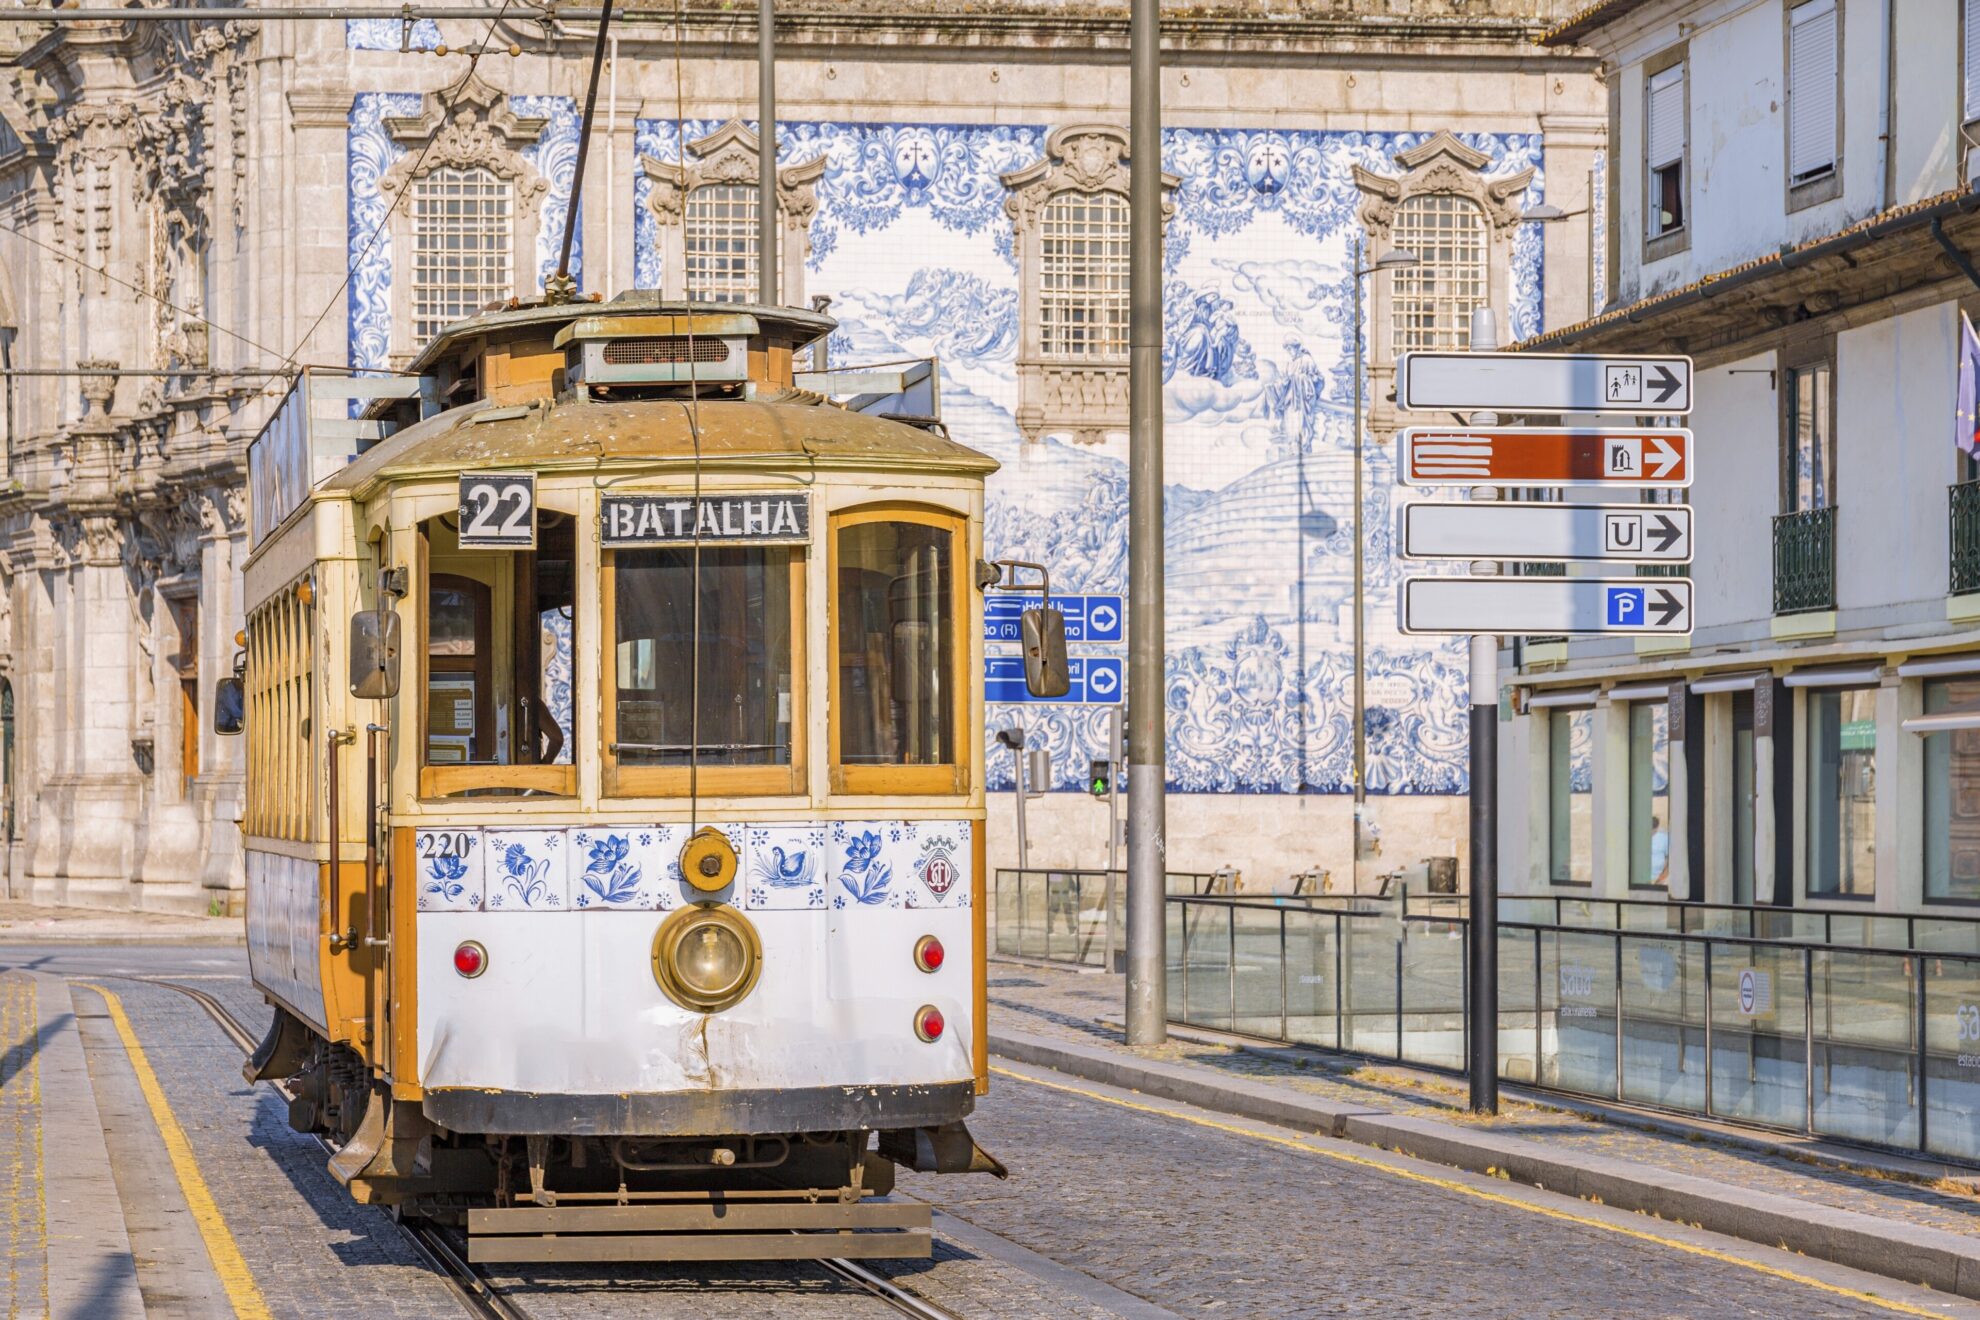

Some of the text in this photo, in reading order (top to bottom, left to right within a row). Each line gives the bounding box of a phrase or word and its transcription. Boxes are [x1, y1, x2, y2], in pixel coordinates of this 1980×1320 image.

[467, 484, 532, 536] 22
[609, 500, 801, 537] BATALHA
[1000, 623, 1018, 638] (R)
[422, 832, 470, 859] 220
